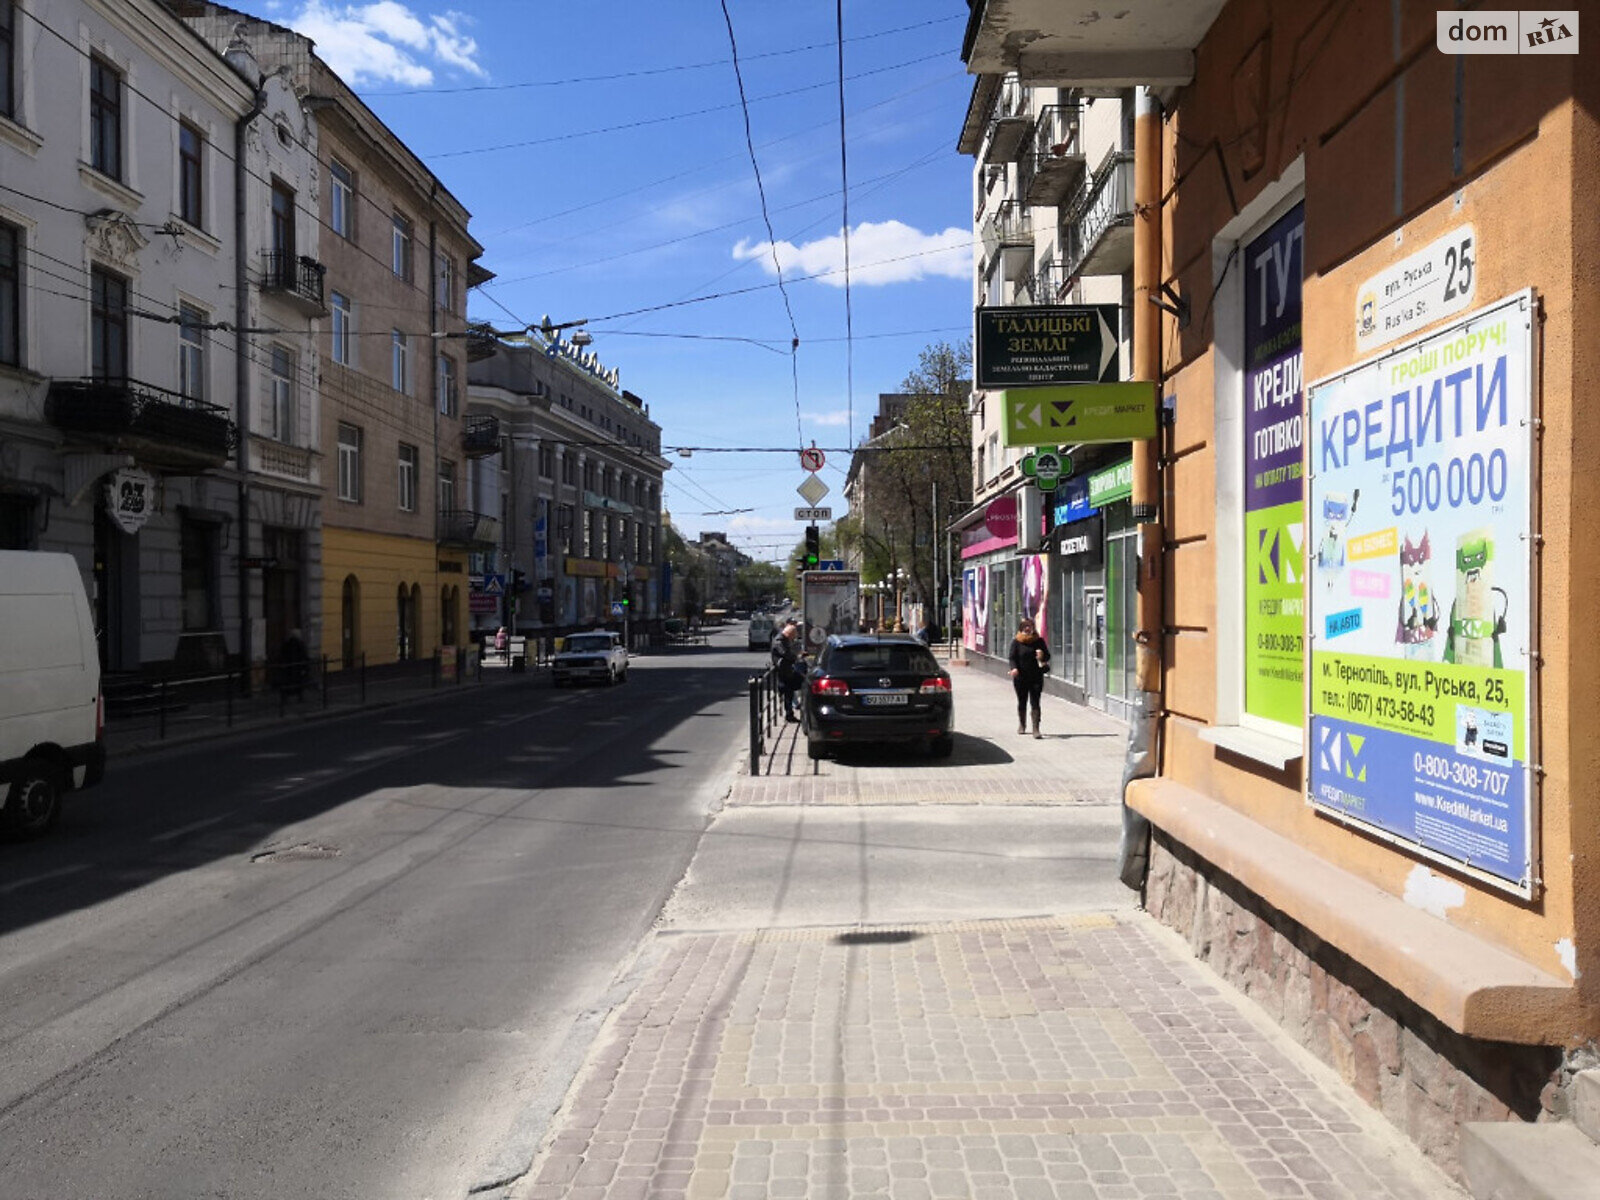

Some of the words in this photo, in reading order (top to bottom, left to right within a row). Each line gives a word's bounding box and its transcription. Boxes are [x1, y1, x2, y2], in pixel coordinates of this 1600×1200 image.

[1443, 238, 1473, 303] 25
[1391, 349, 1439, 386] ГРОШІ
[1443, 321, 1507, 366] ПОРУЧ!
[1322, 354, 1507, 473] КРЕДИТИ
[1391, 462, 1441, 516] 500
[1447, 448, 1507, 508] 000
[798, 510, 828, 518] СТОП
[1258, 632, 1303, 652] 0-800-308-7
[1334, 660, 1393, 690] Тернопіль,
[1396, 671, 1421, 694] вул.
[1425, 670, 1480, 704] Руська,
[1485, 678, 1509, 708] 25,
[1322, 690, 1345, 708] тел.:
[1348, 691, 1374, 719] (067)
[1376, 696, 1435, 727] 473-58-43
[1414, 752, 1510, 797] 0-800-308-707
[1415, 791, 1509, 833] www.KreditMarket.ua
